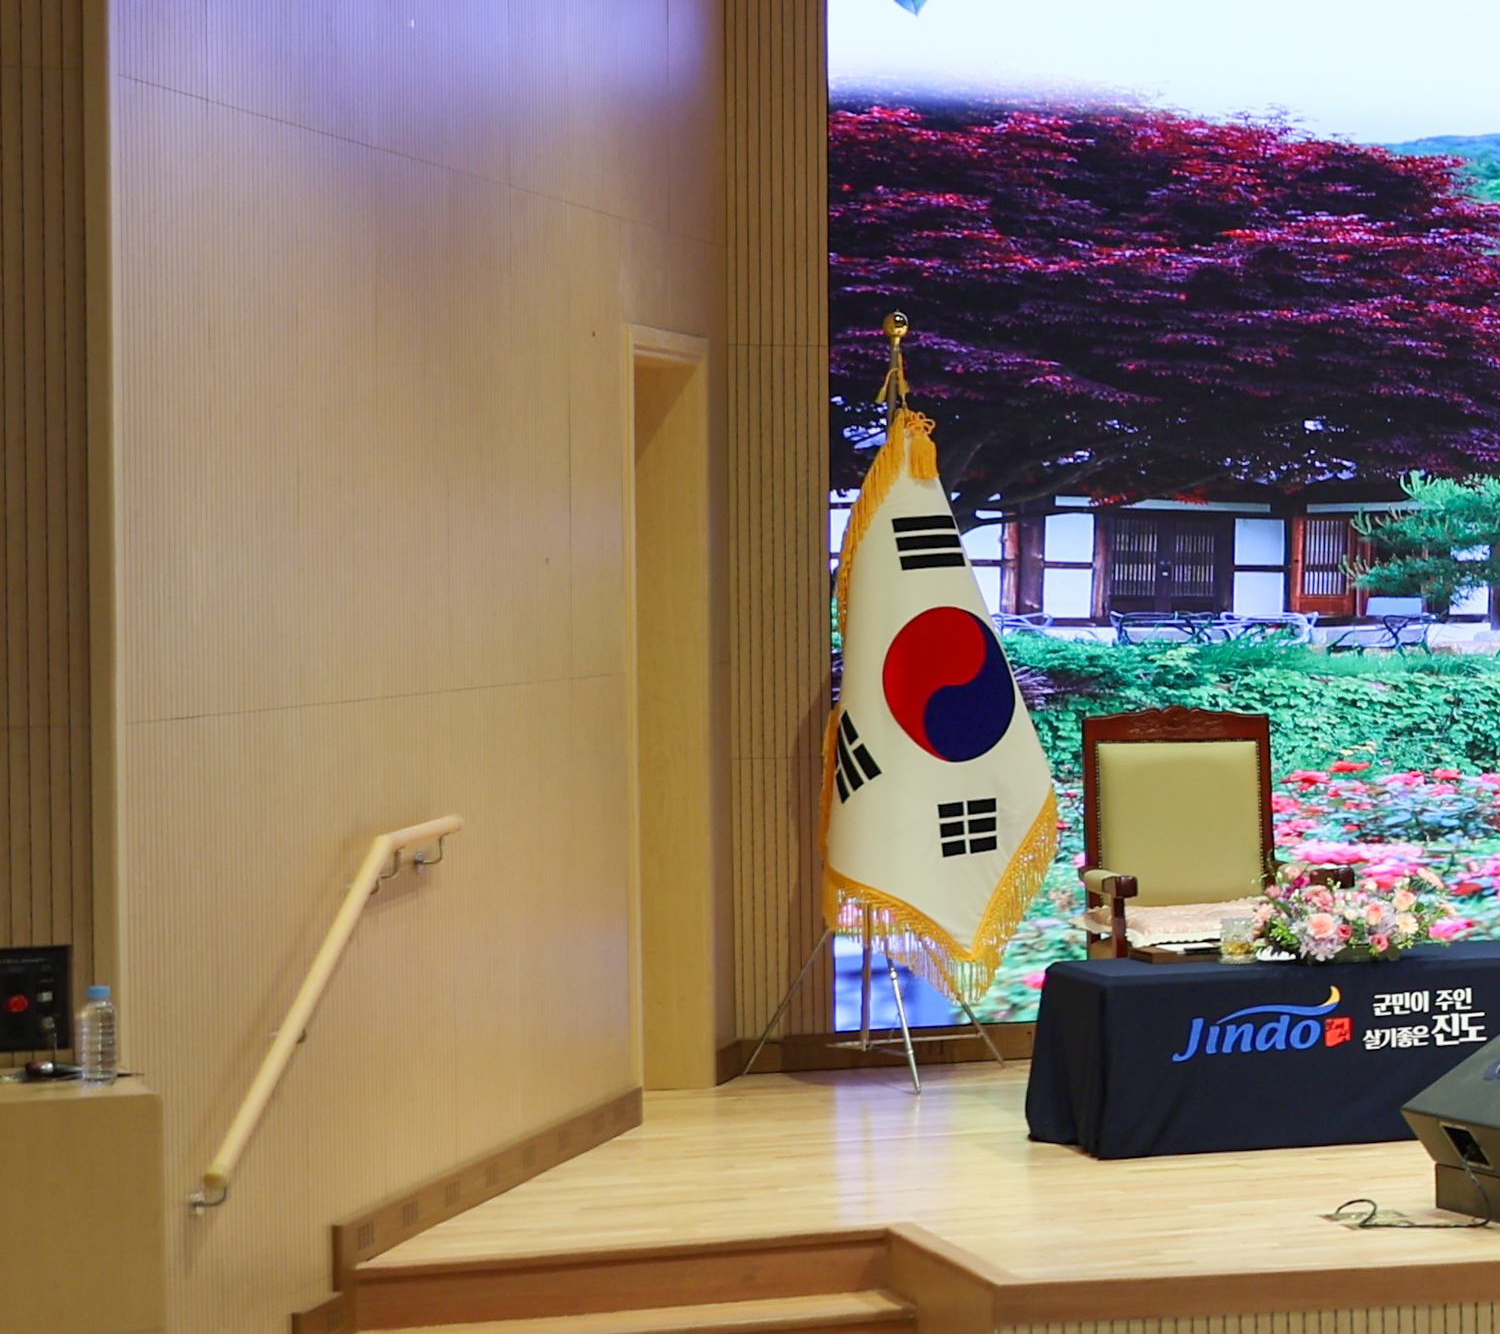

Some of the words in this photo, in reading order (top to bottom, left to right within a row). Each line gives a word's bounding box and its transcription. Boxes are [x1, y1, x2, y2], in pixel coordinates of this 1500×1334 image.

[1372, 990, 1430, 1016] 군민이
[1435, 987, 1472, 1011] 주인
[1172, 1015, 1322, 1062] Jindo
[1362, 1025, 1430, 1050] 살기좋은
[1431, 1012, 1488, 1046] 진도
